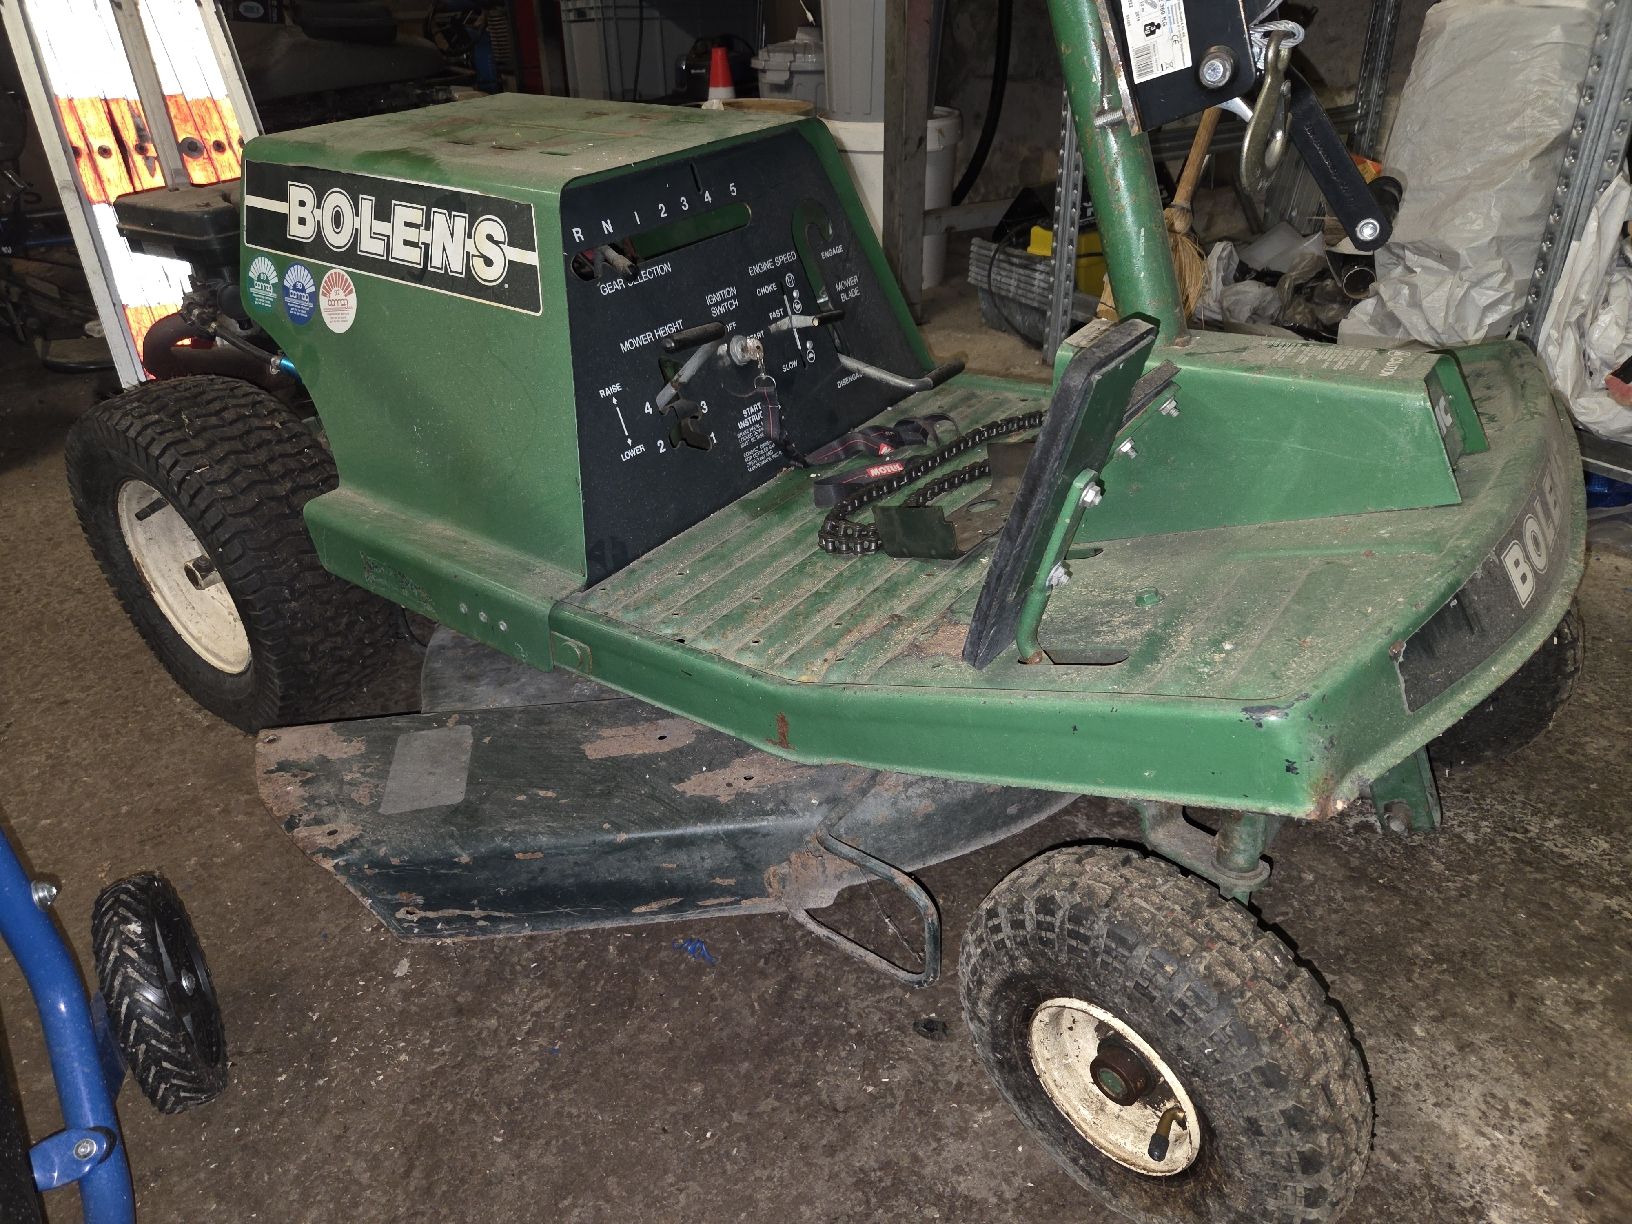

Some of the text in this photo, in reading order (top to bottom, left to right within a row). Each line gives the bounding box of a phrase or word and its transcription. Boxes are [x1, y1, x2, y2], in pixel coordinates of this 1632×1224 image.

[572, 227, 584, 243] R
[601, 219, 613, 235] N
[658, 203, 668, 218] 2
[680, 196, 689, 211] 3
[704, 190, 712, 204] 4
[729, 182, 737, 196] 5
[287, 181, 508, 287] BOLENS
[821, 244, 844, 260] ENGAGE
[748, 251, 797, 277] ENGINE SPEED
[600, 261, 672, 296] GEAR LECTION
[835, 274, 859, 293] MOWER
[705, 286, 738, 306] IGNITION
[756, 282, 778, 297] CHOKE
[840, 287, 861, 302] BLADE
[710, 298, 739, 318] SWITCH
[768, 308, 784, 321] FAST
[726, 321, 737, 333] FF
[619, 319, 684, 354] MOWER HEIGHT
[782, 359, 798, 373] SLOW
[599, 383, 623, 399] RAISE
[644, 401, 653, 415] 4
[700, 400, 709, 414] 3
[742, 401, 762, 418] START
[620, 444, 646, 462] LOWER
[657, 439, 667, 454] 2
[870, 463, 903, 477] MOTUL
